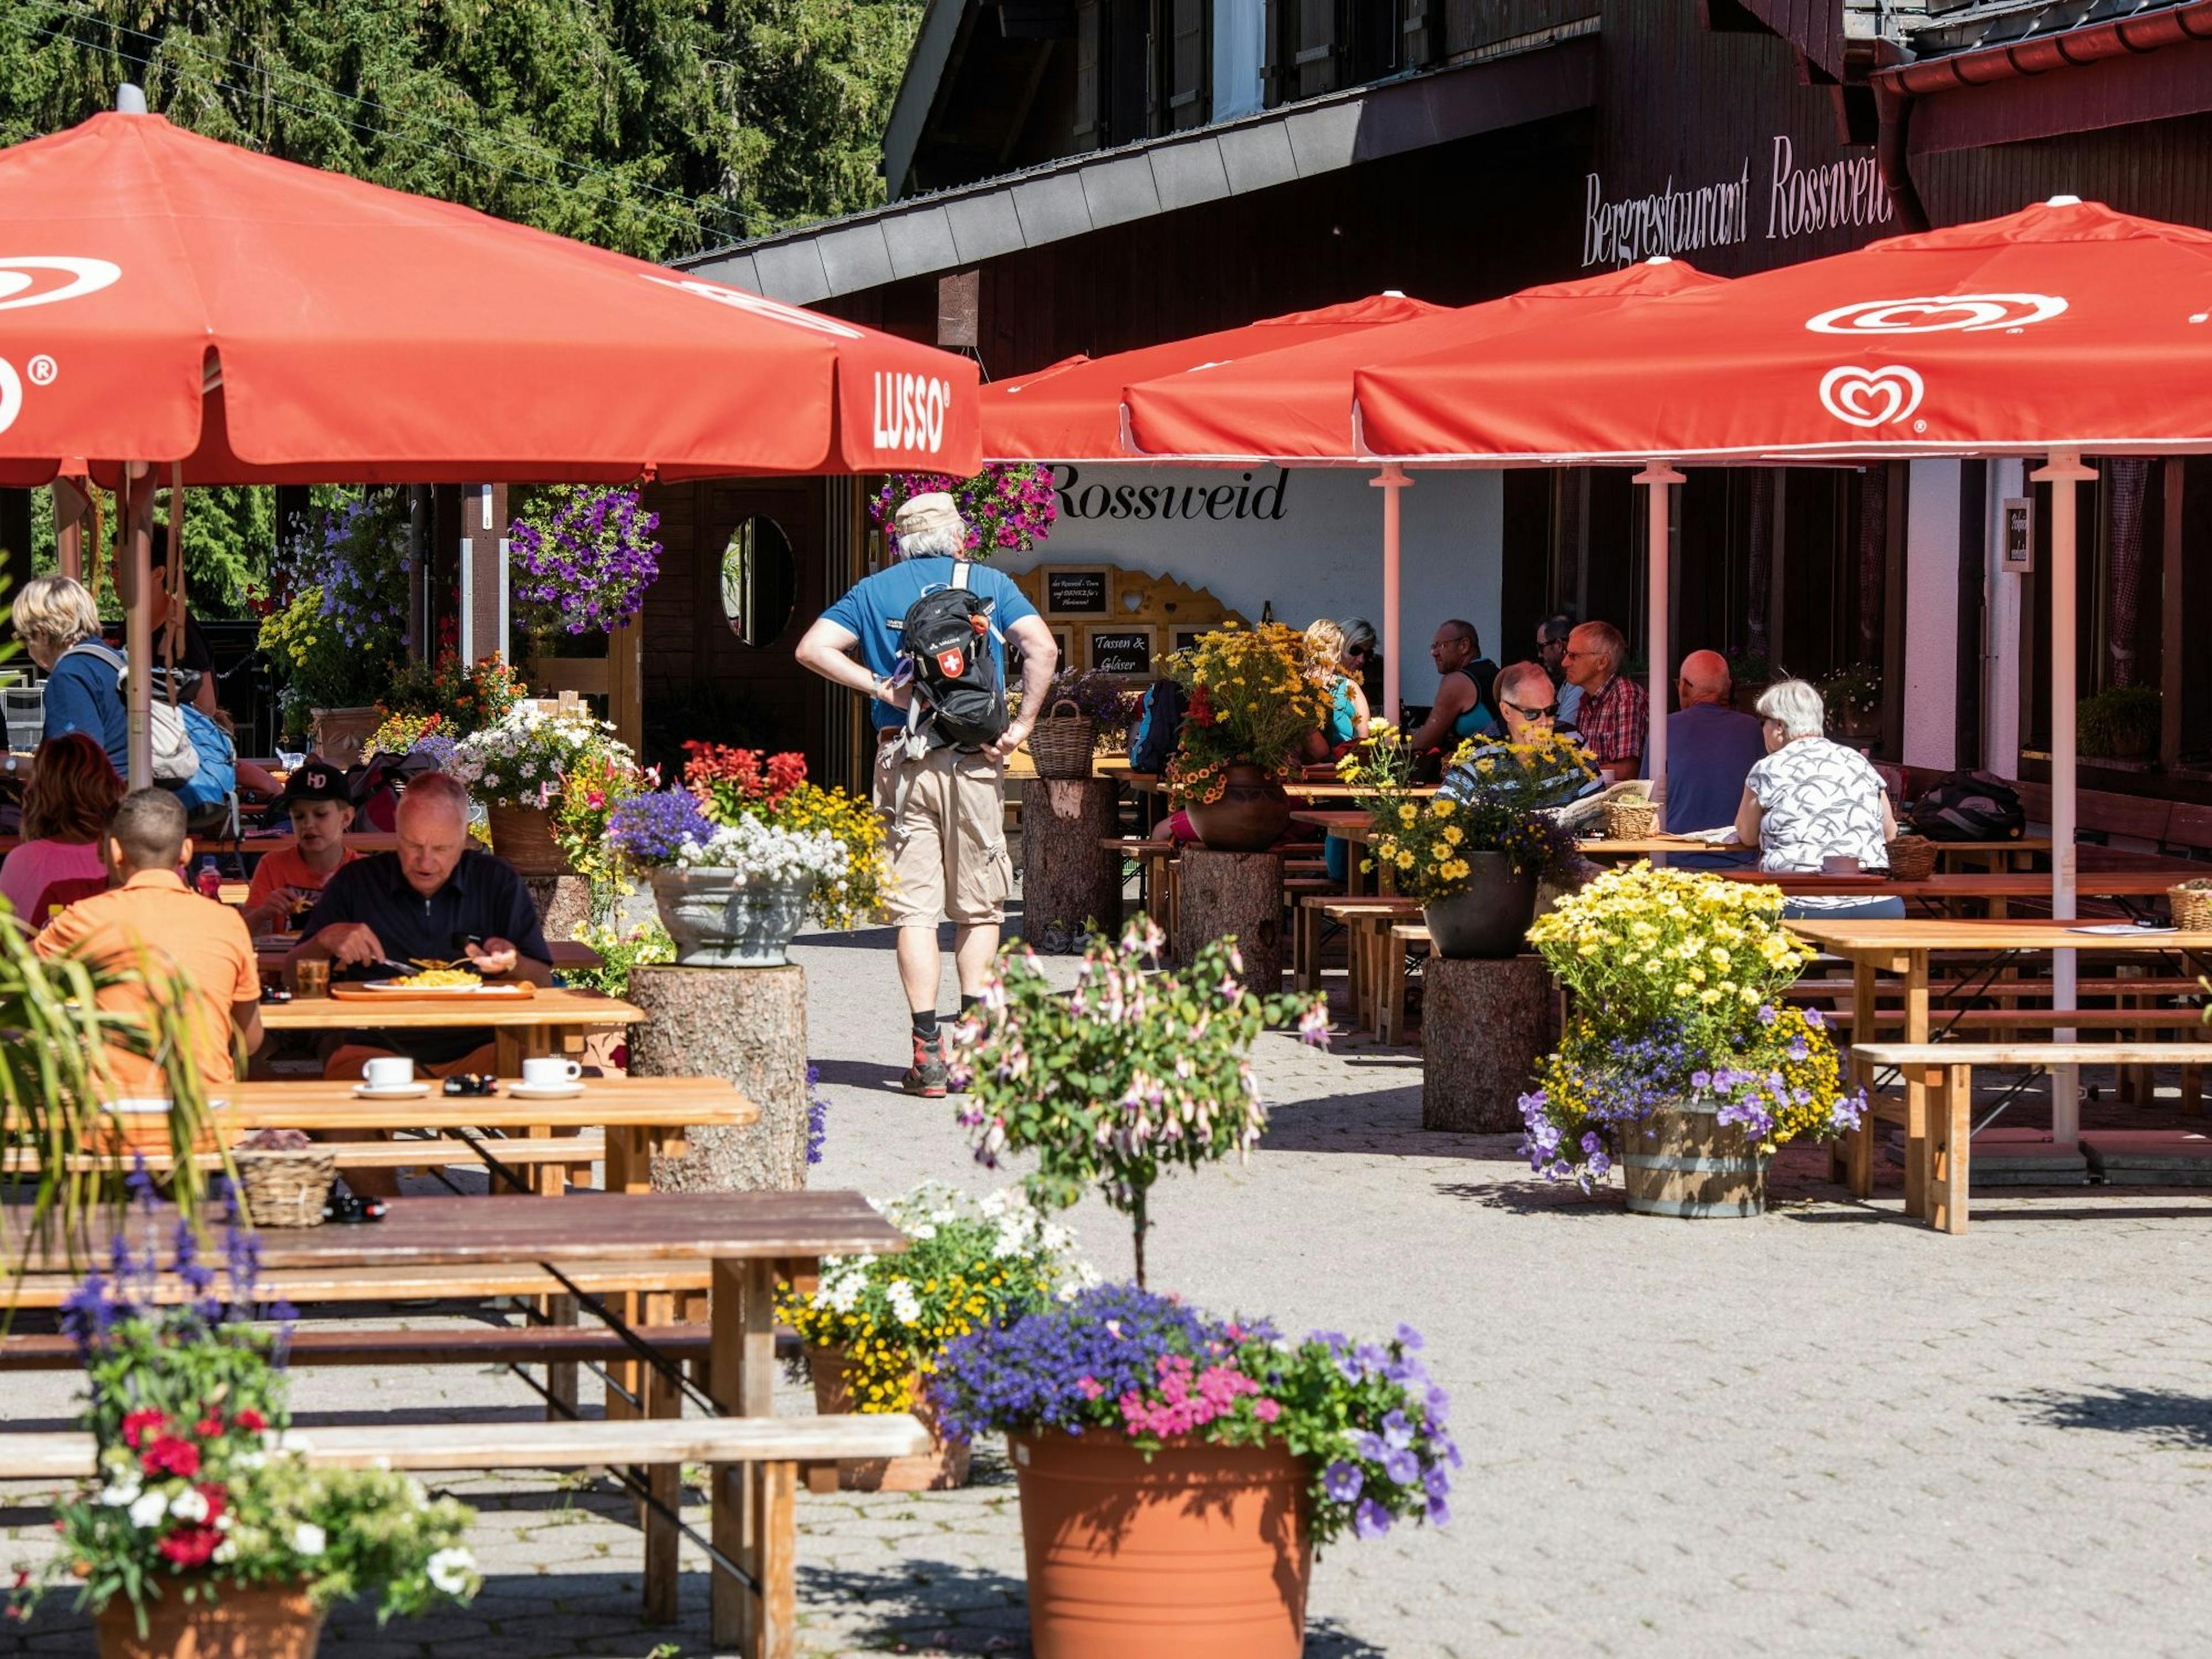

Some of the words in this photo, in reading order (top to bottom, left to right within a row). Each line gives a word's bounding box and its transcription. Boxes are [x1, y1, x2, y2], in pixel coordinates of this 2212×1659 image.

[1581, 156, 1749, 272] Bergrestaurant
[1047, 464, 1288, 520] Rossweid
[1095, 636, 1131, 649] Tassen
[1133, 637, 1145, 650] &
